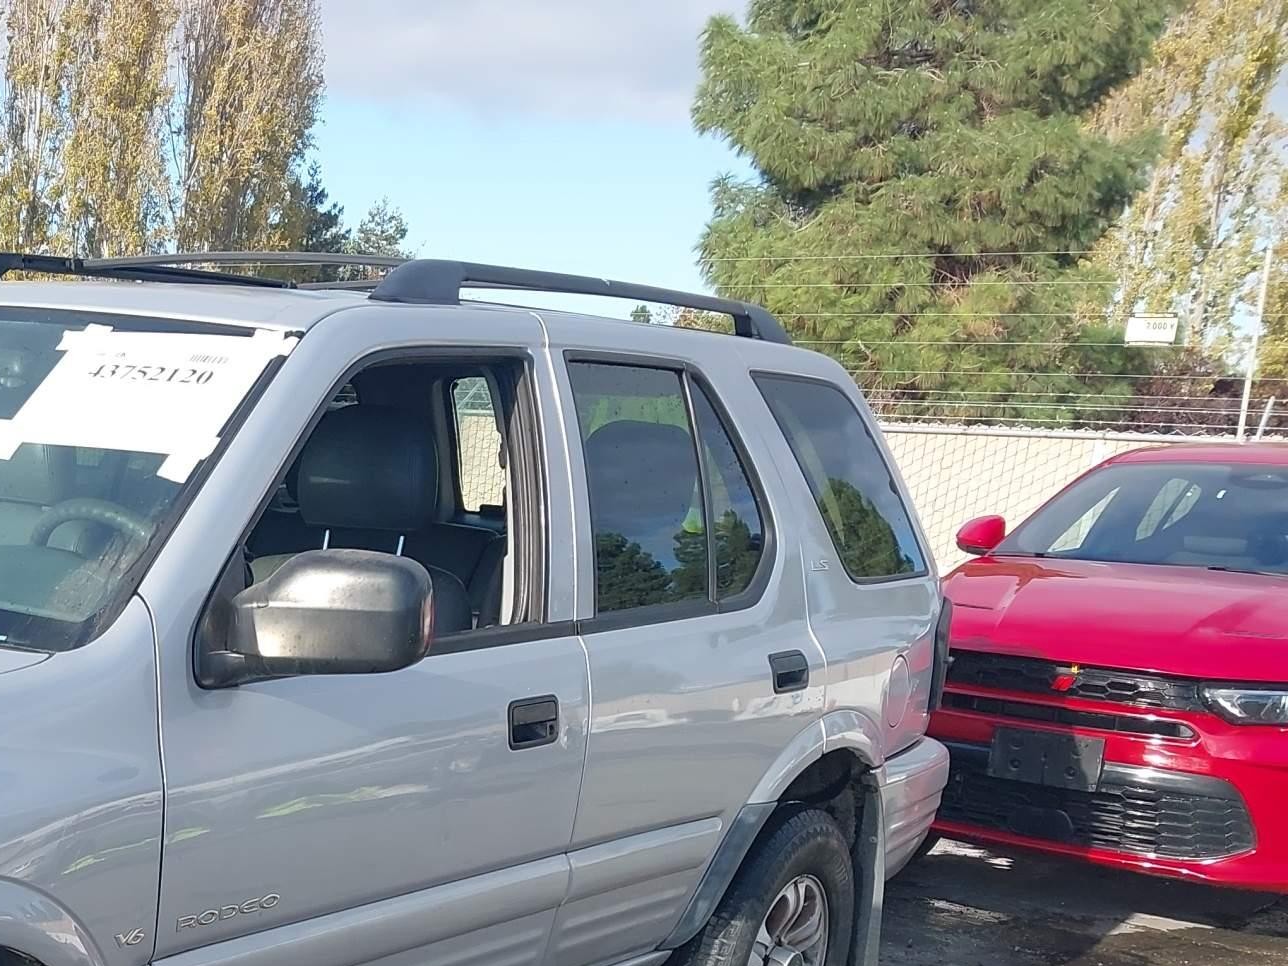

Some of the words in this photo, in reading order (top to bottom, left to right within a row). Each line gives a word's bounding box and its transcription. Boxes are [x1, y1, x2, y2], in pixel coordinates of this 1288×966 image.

[88, 364, 214, 385] 43752120
[176, 893, 280, 932] RODEO
[114, 927, 145, 949] V6
